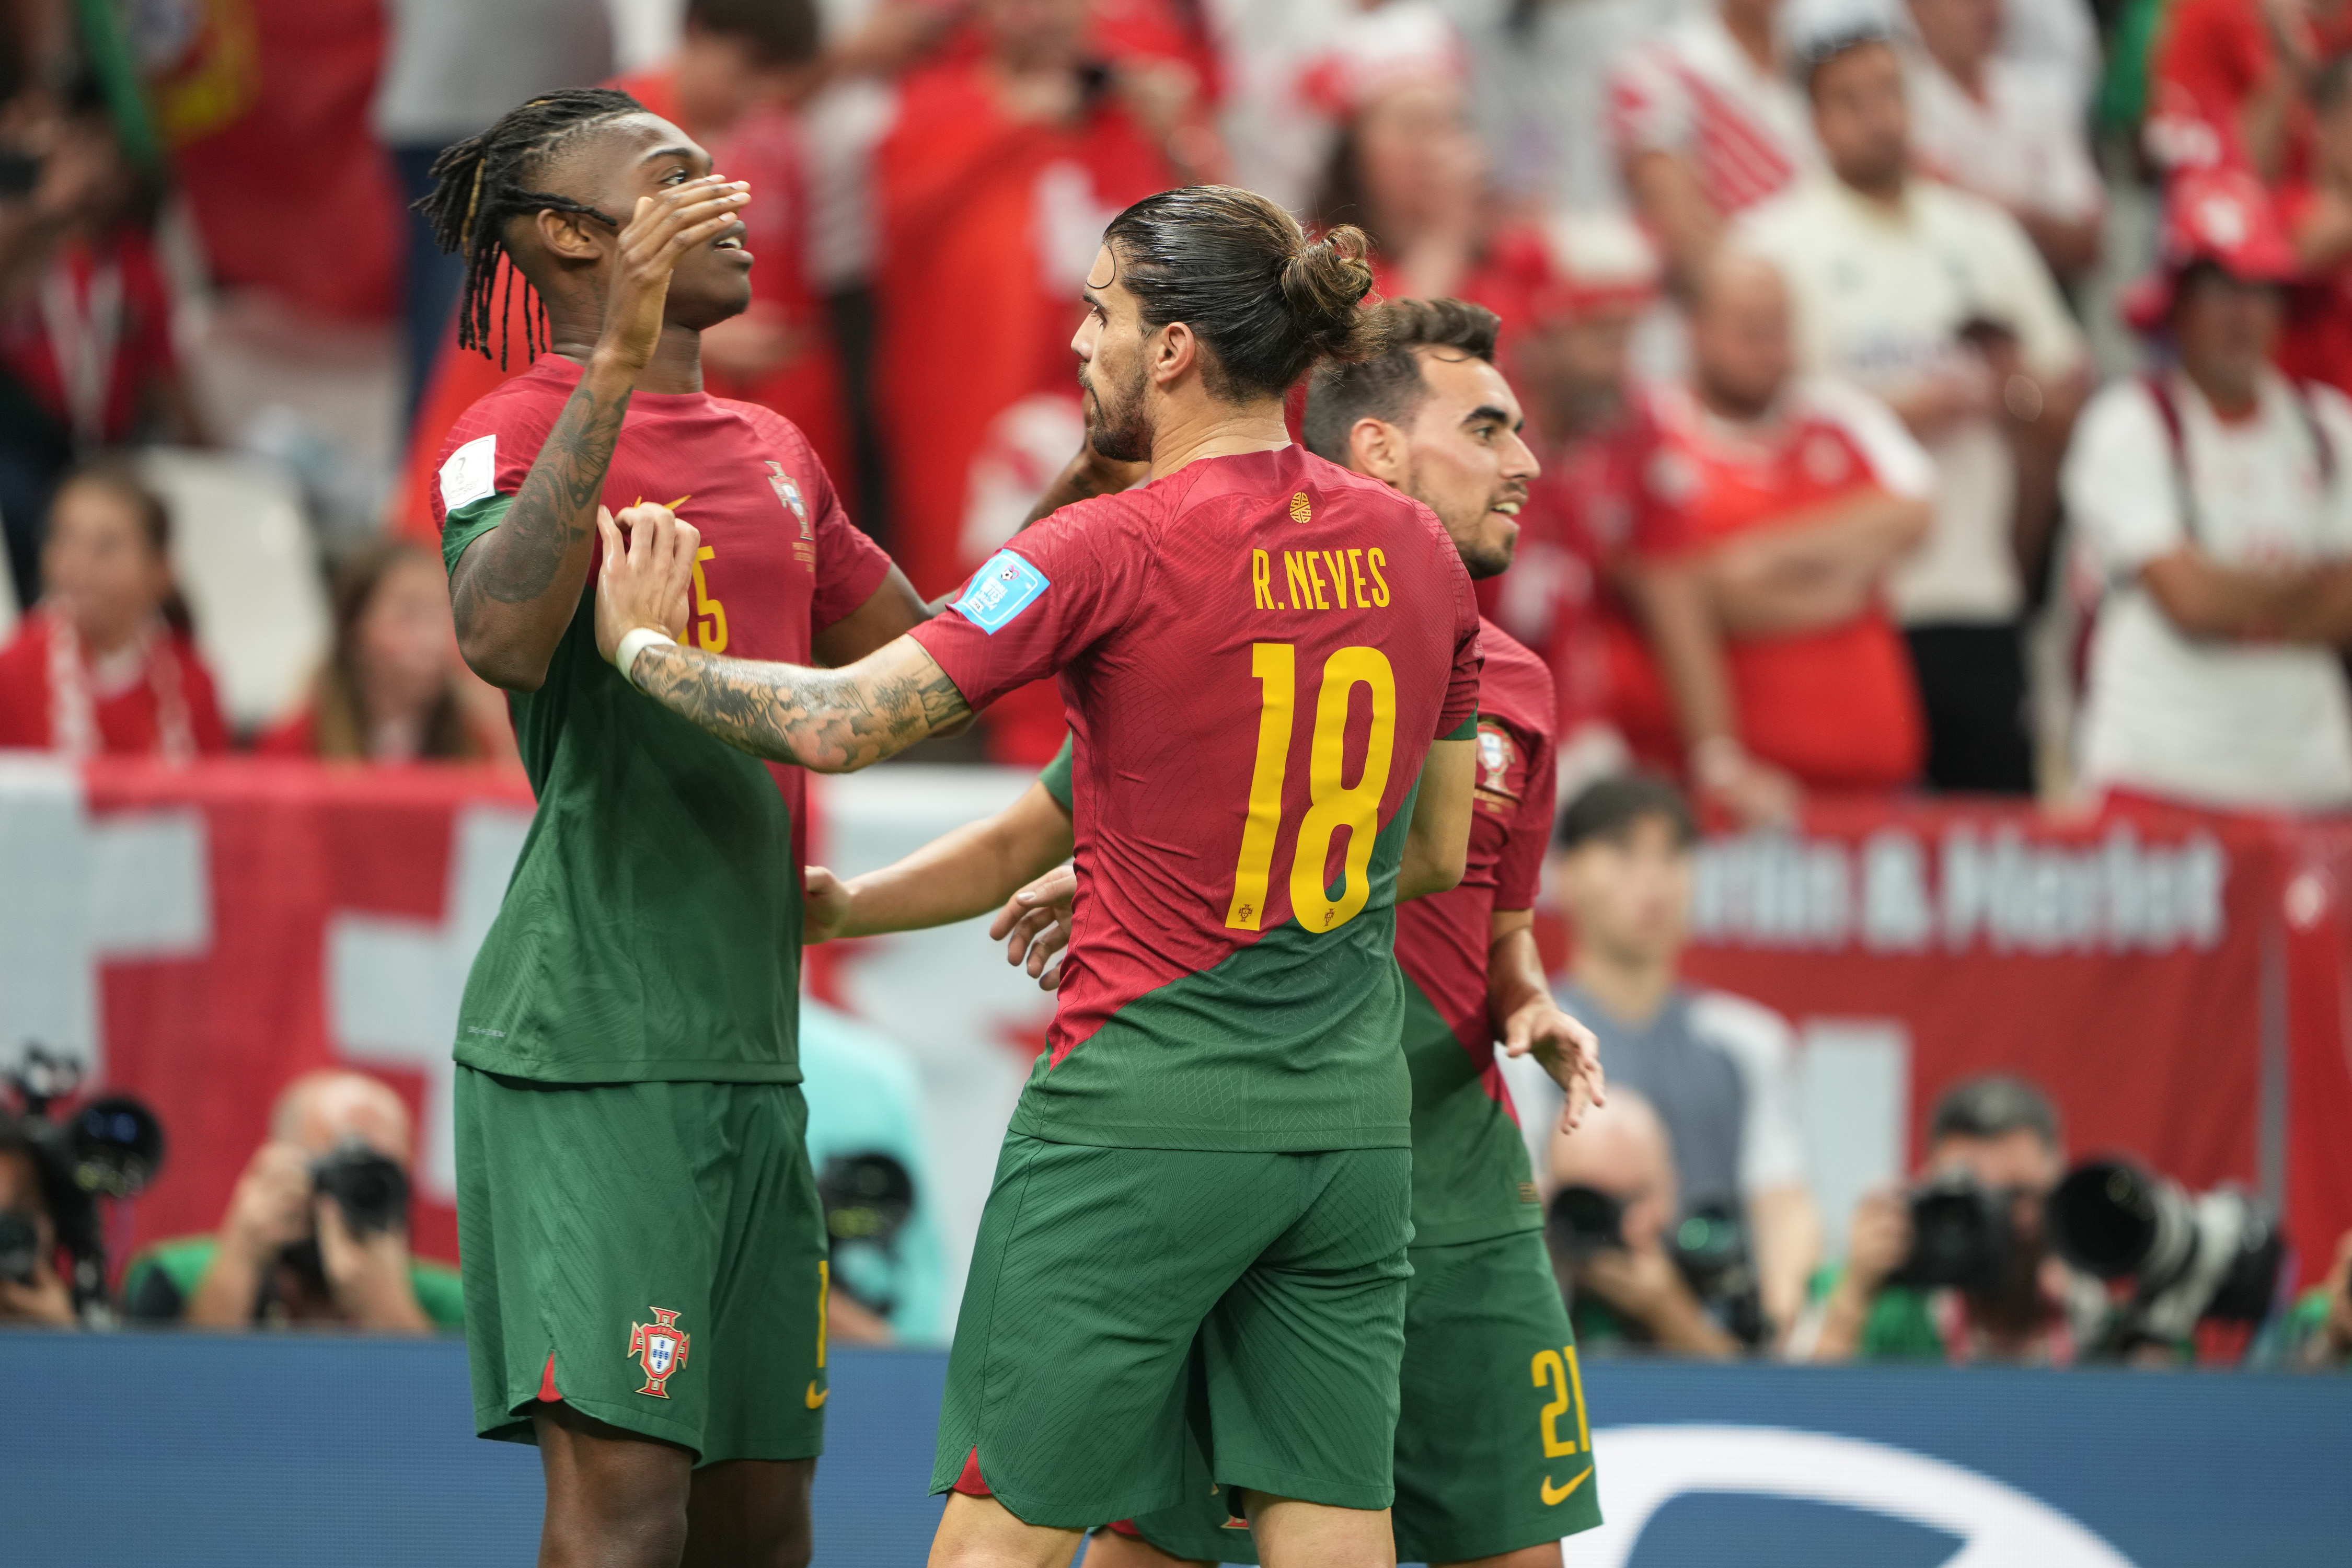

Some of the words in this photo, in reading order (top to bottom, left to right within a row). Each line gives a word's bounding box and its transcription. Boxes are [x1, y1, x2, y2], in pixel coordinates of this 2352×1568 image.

[677, 545, 729, 654] 5
[1252, 547, 1390, 610] R.NEVES
[1225, 642, 1396, 934] 18
[1531, 1345, 1590, 1458] 21
